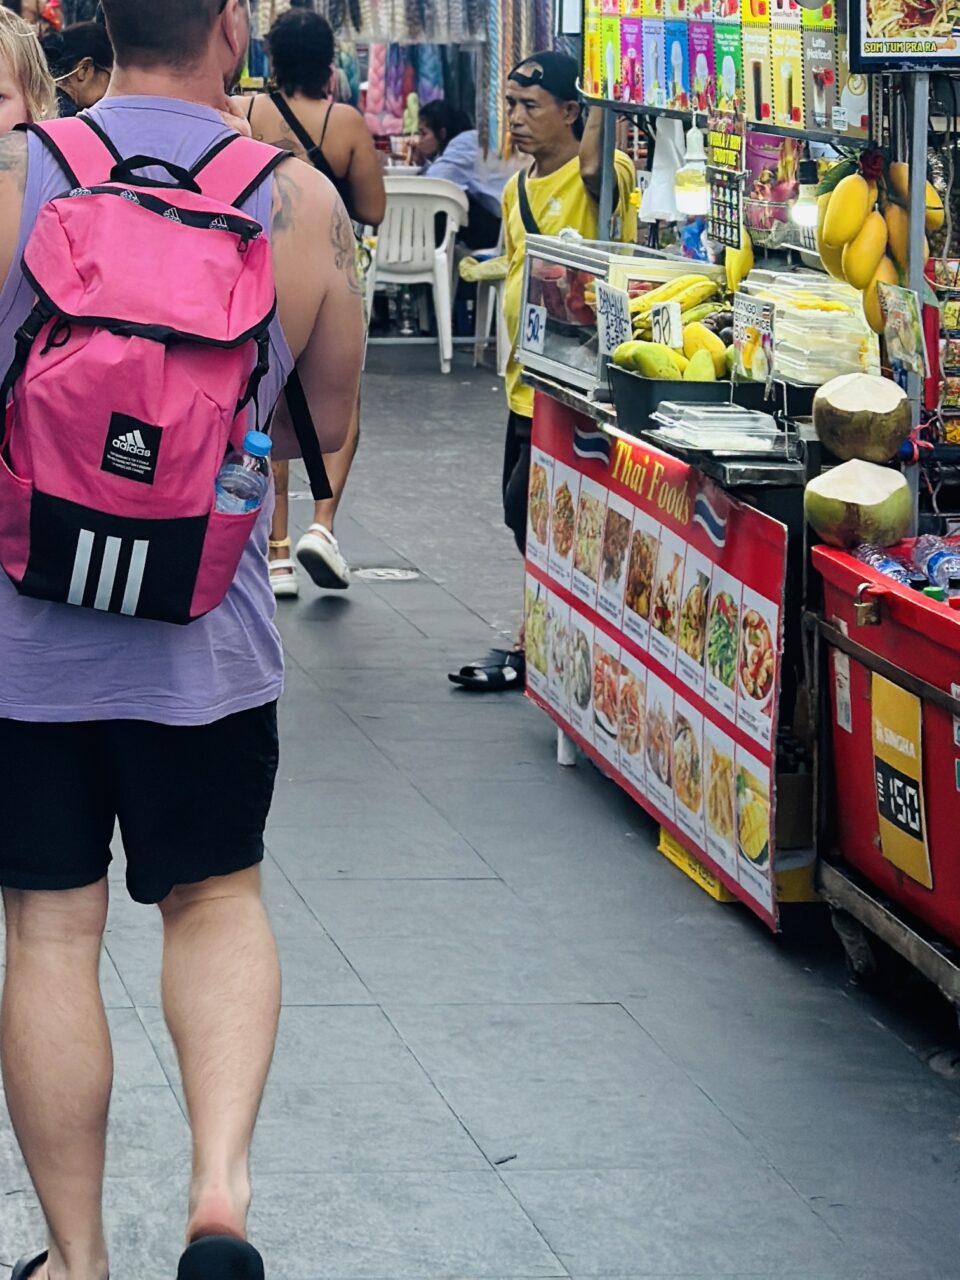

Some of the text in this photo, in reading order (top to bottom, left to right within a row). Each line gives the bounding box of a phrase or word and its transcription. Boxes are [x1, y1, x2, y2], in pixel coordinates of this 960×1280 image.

[864, 41, 938, 53] SOM TUM PRA RA
[735, 301, 757, 315] MANGO
[755, 317, 770, 331] RICE
[112, 438, 151, 457] adidas
[611, 439, 691, 526] Thai Foods
[883, 727, 916, 759] SINGHA
[876, 772, 921, 832] THB 150
